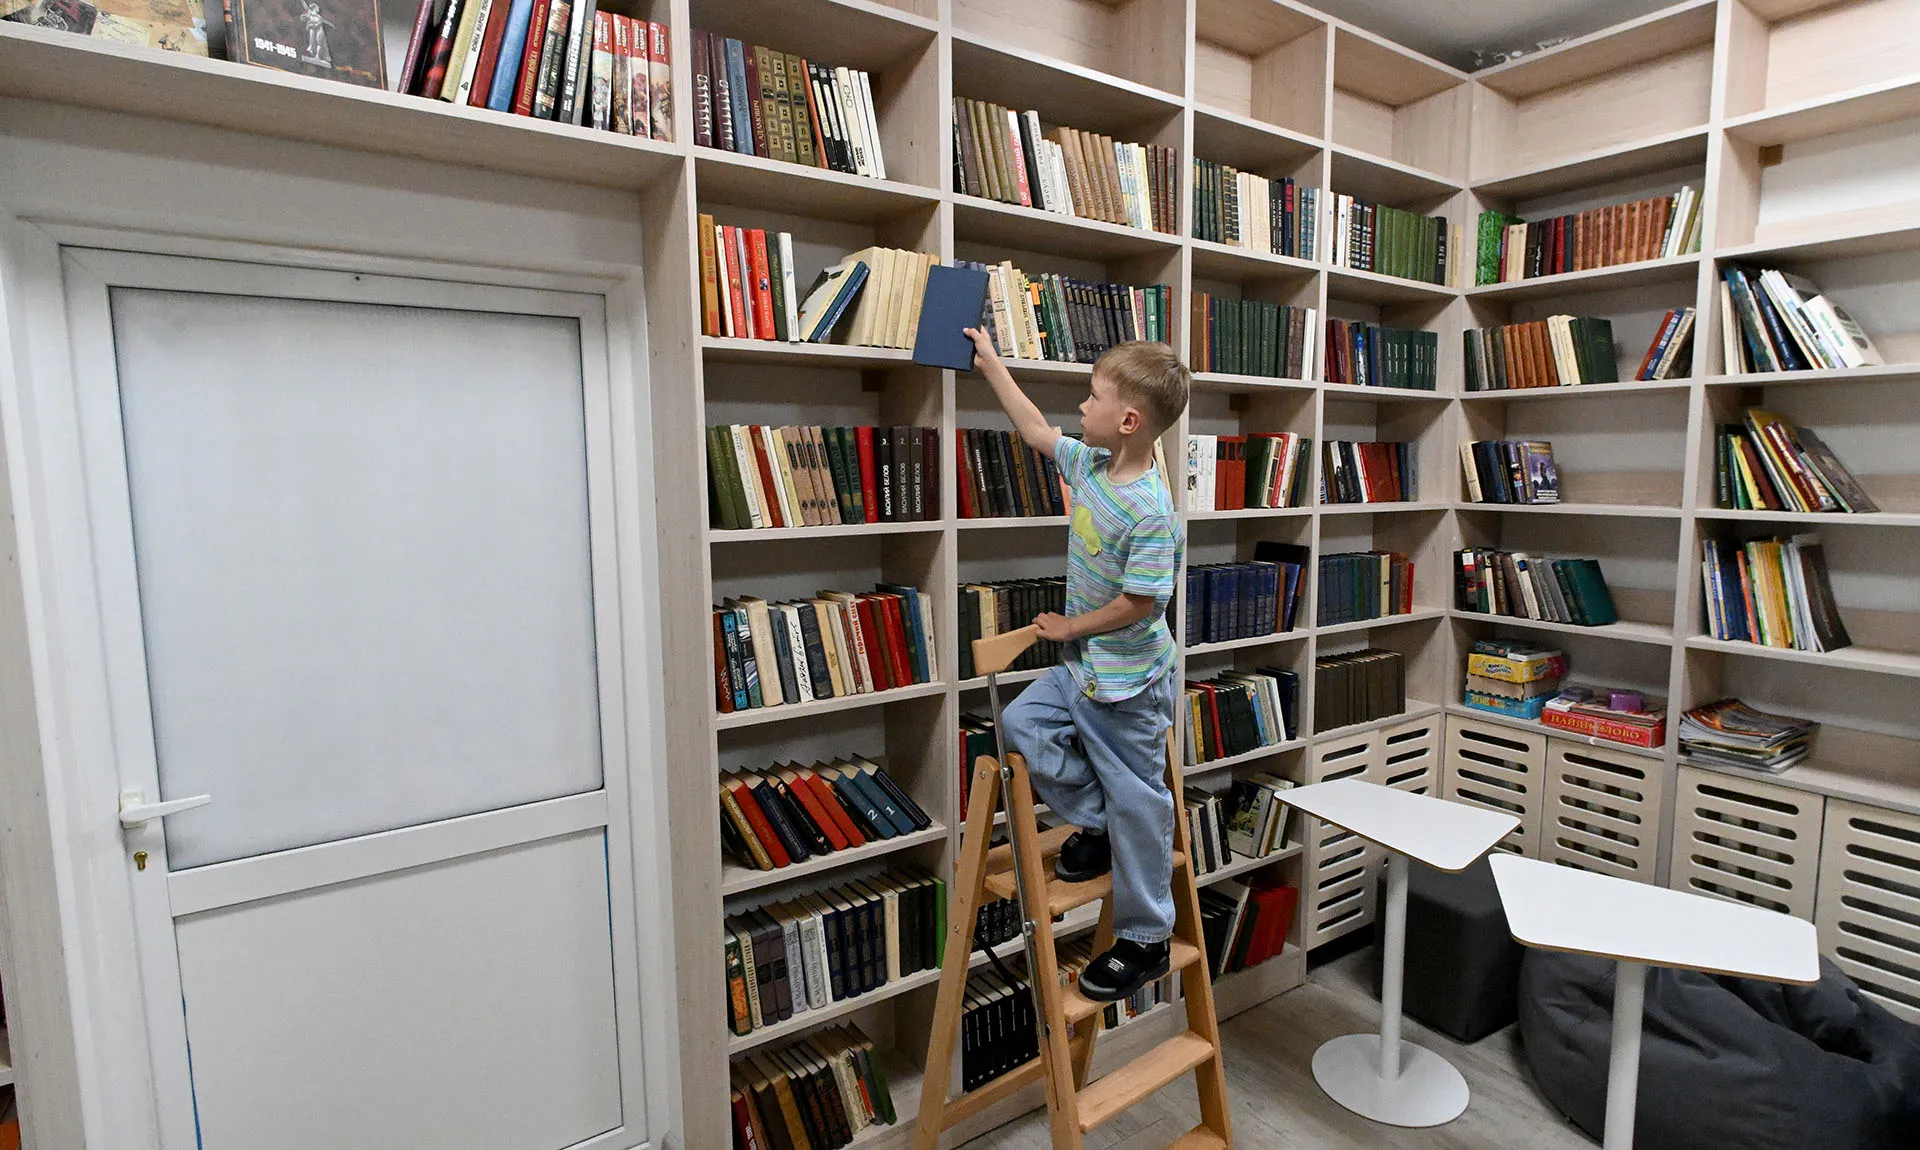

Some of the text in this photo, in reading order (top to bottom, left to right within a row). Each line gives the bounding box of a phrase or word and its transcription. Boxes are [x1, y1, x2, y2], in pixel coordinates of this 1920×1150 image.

[753, 99, 764, 141] АДАМОВИЧ
[1014, 148, 1025, 183] АРКАДИЙ
[882, 437, 888, 445] 3
[883, 486, 891, 516] ВАСИЛИЙ
[867, 809, 878, 821] 2
[885, 806, 896, 816] 1
